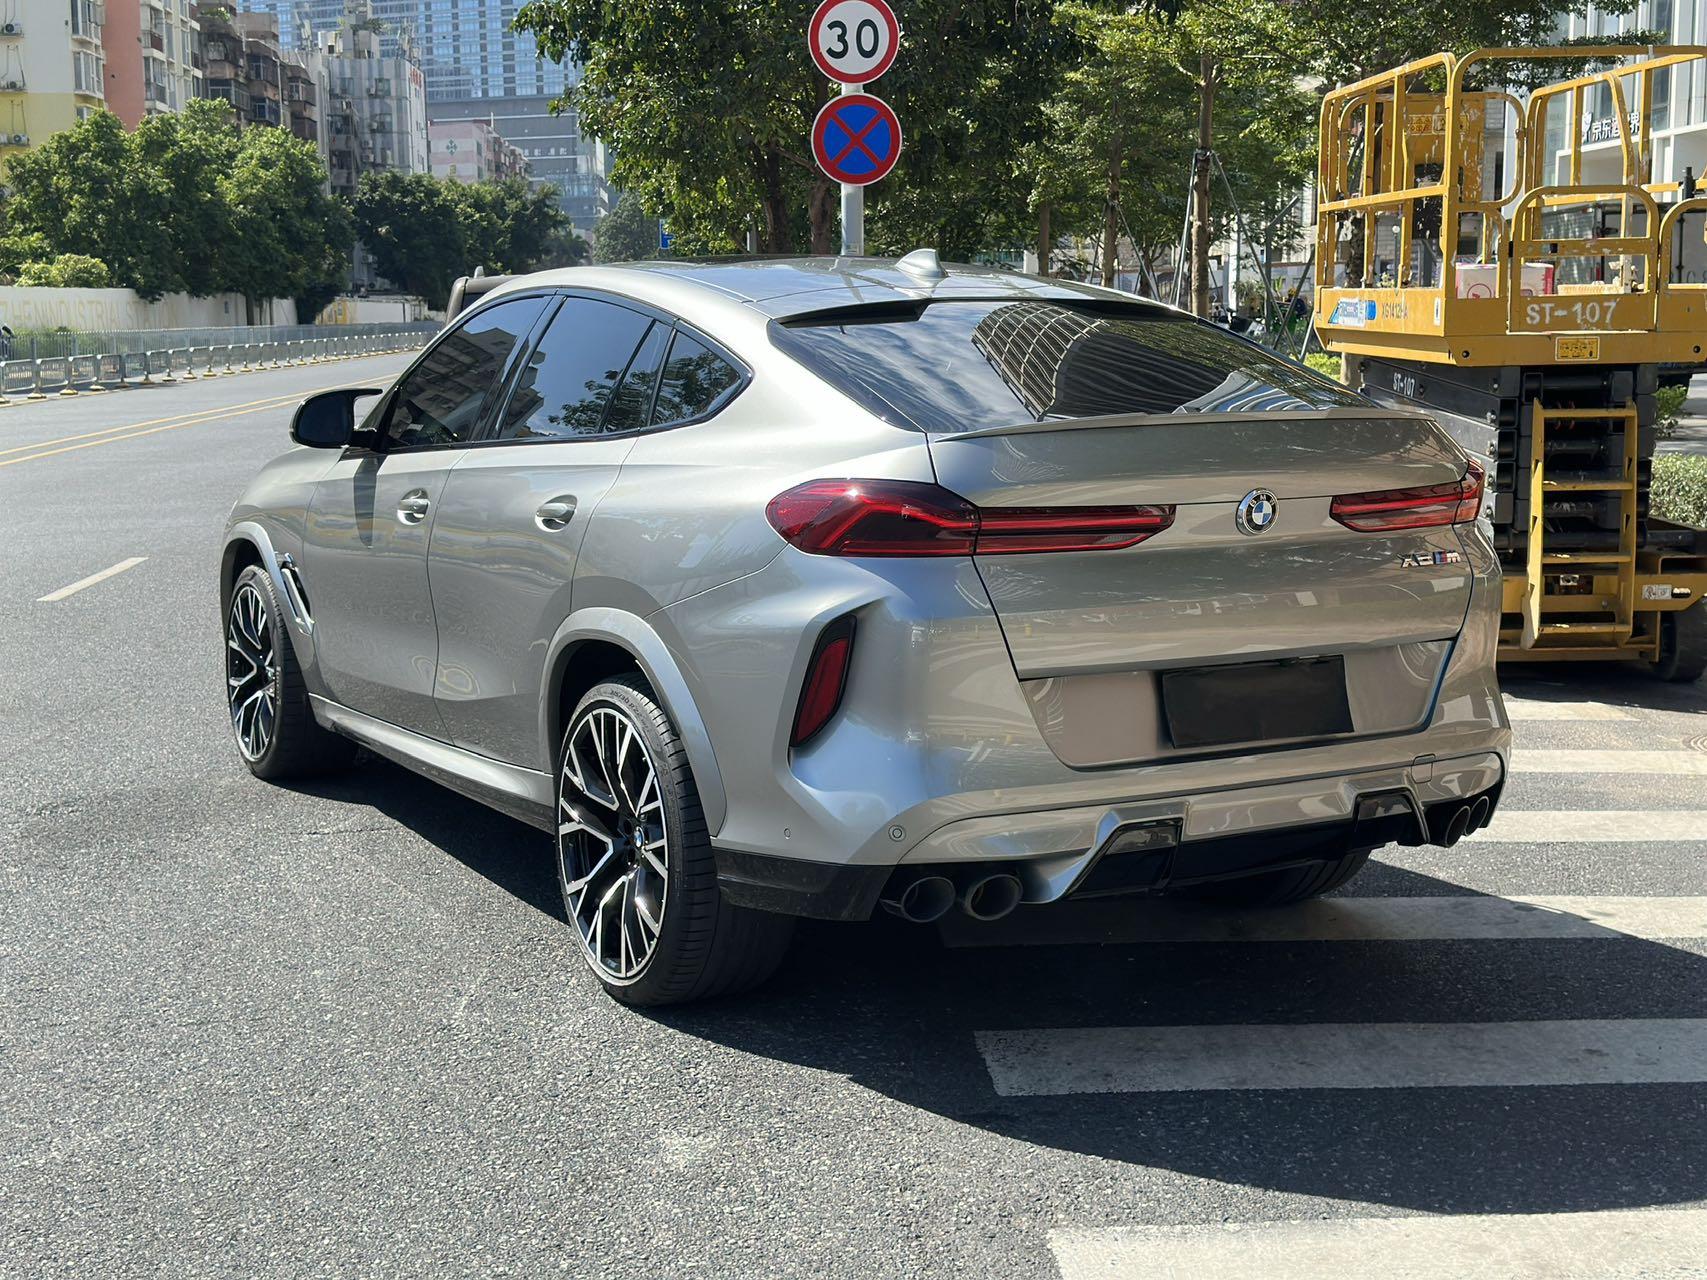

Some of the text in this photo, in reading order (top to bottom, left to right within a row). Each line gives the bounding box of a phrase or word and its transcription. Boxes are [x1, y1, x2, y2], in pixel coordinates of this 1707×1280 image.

[825, 18, 880, 60] 30
[1592, 112, 1641, 142] 京东酒界
[1525, 302, 1617, 325] ST-107
[1392, 371, 1416, 398] ST-107
